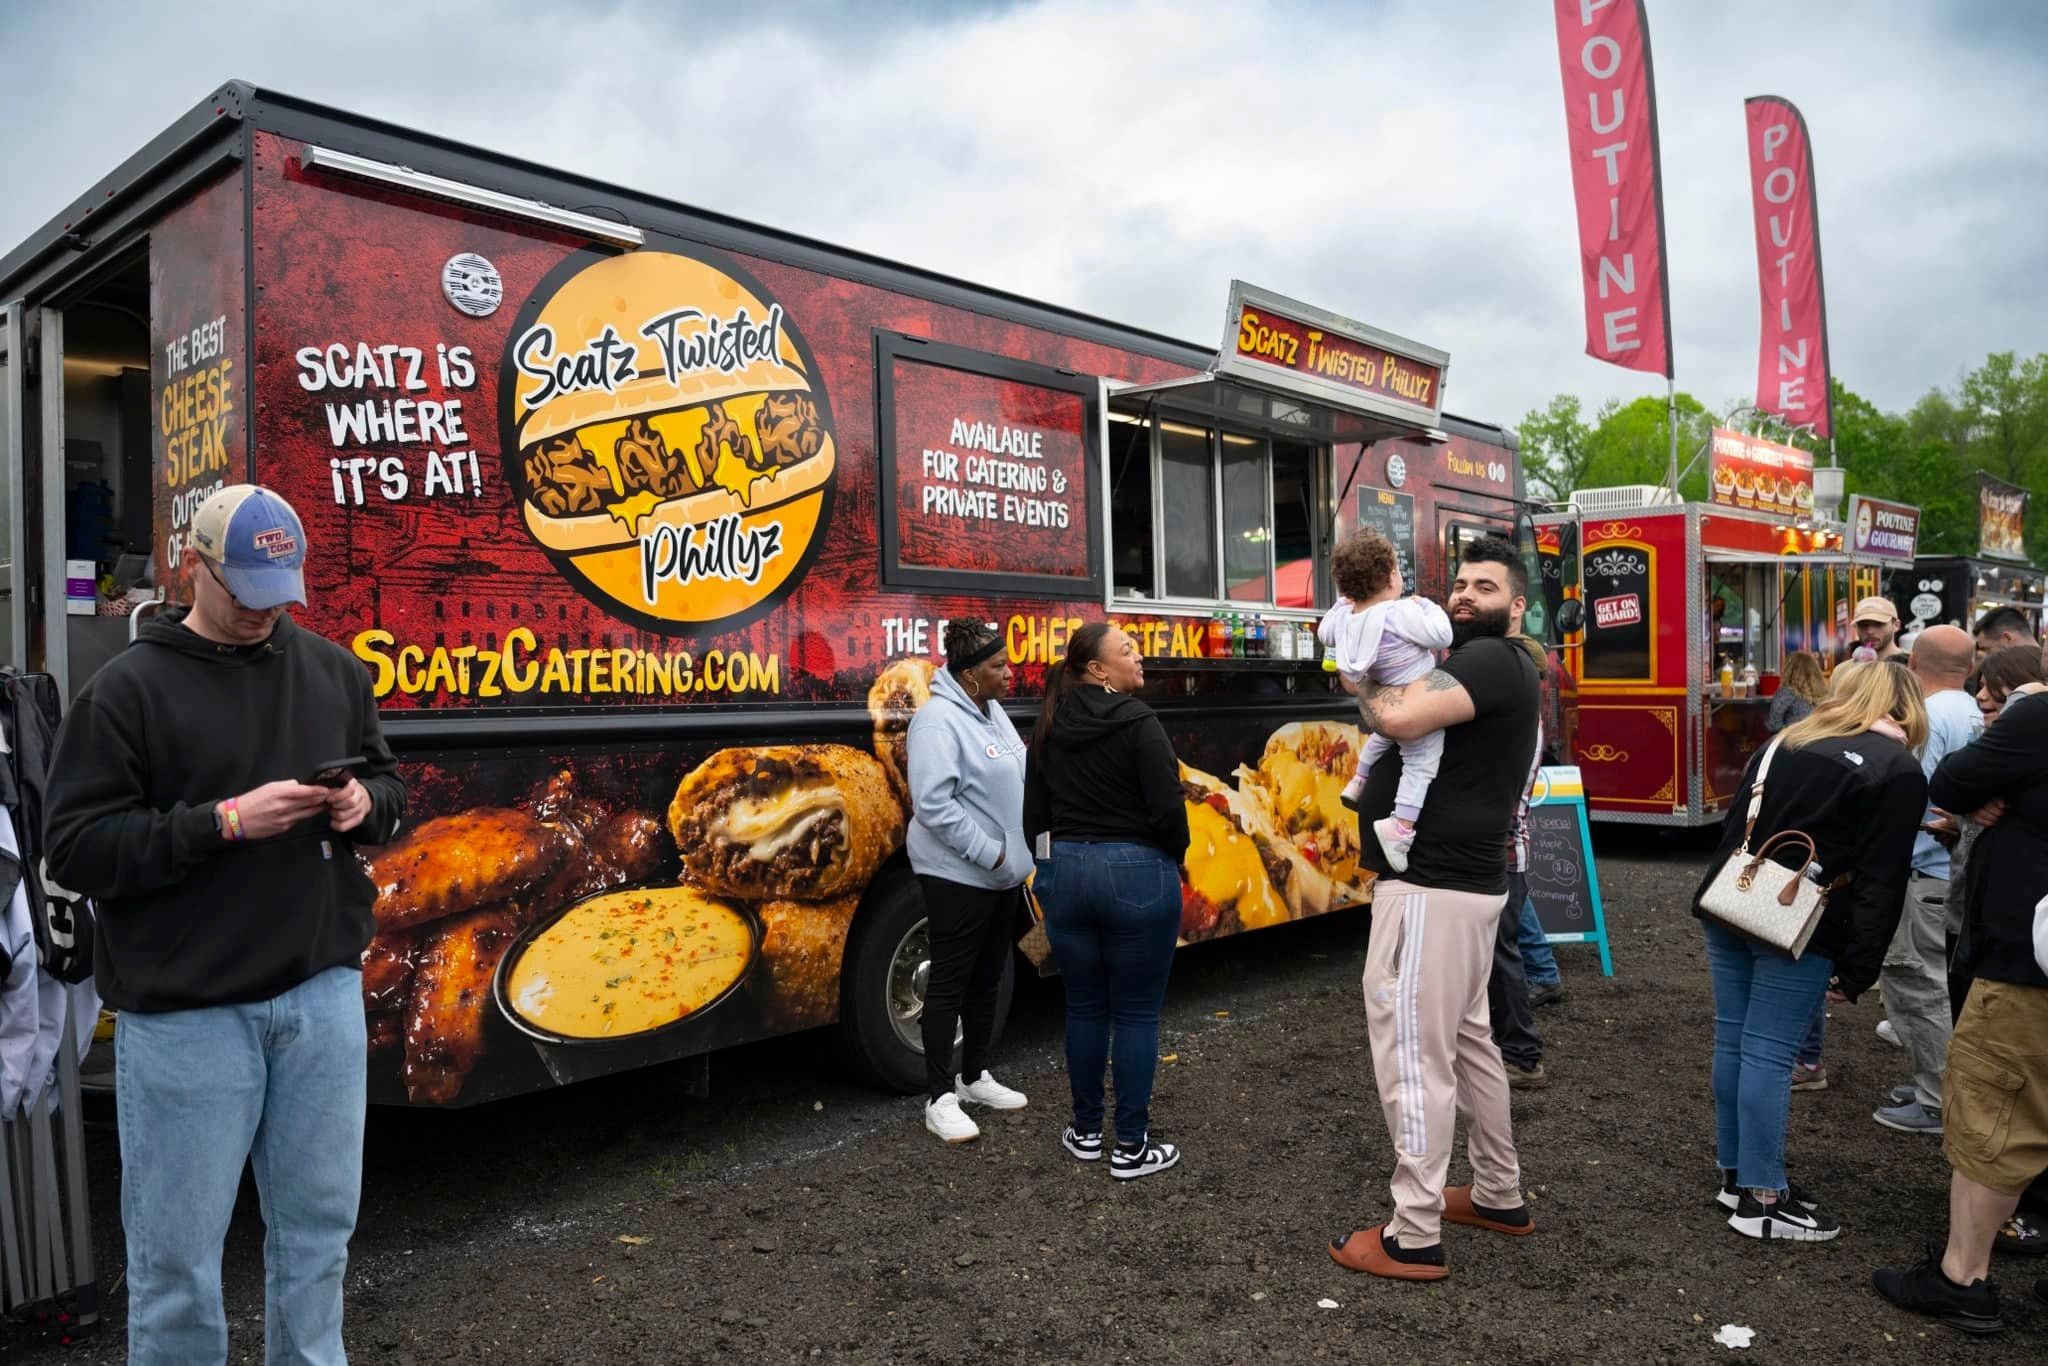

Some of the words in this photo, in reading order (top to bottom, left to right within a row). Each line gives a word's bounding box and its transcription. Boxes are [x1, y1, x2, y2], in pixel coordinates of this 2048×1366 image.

[1763, 124, 1807, 411] POUTINE
[165, 334, 189, 379] THE
[192, 314, 226, 365] BEST
[296, 342, 428, 391] SCATZ
[514, 325, 639, 407] Scatz
[640, 305, 783, 386] Twisted
[1238, 313, 1299, 365] SCATZ
[1308, 332, 1376, 386] TWISTED
[1381, 354, 1432, 403] PHILLYZ
[161, 358, 233, 437] CHEESE
[325, 398, 468, 447] WHERE
[950, 417, 1043, 459] AVAILABLE
[167, 416, 228, 488] STEAK
[424, 450, 482, 498] AT!
[922, 449, 960, 482] FOR
[965, 456, 1047, 493] CATERING
[1052, 469, 1067, 494] &
[922, 486, 998, 519] PRIVATE
[1003, 494, 1069, 528] EVENTS
[1876, 511, 1915, 534] POUTINE
[167, 532, 183, 569] OF
[257, 532, 282, 545] TWO
[643, 514, 782, 603] Phillyz
[1598, 601, 1618, 614] GET
[1620, 597, 1637, 610] ON
[1598, 607, 1638, 624] BOARD!
[881, 617, 930, 657] THE
